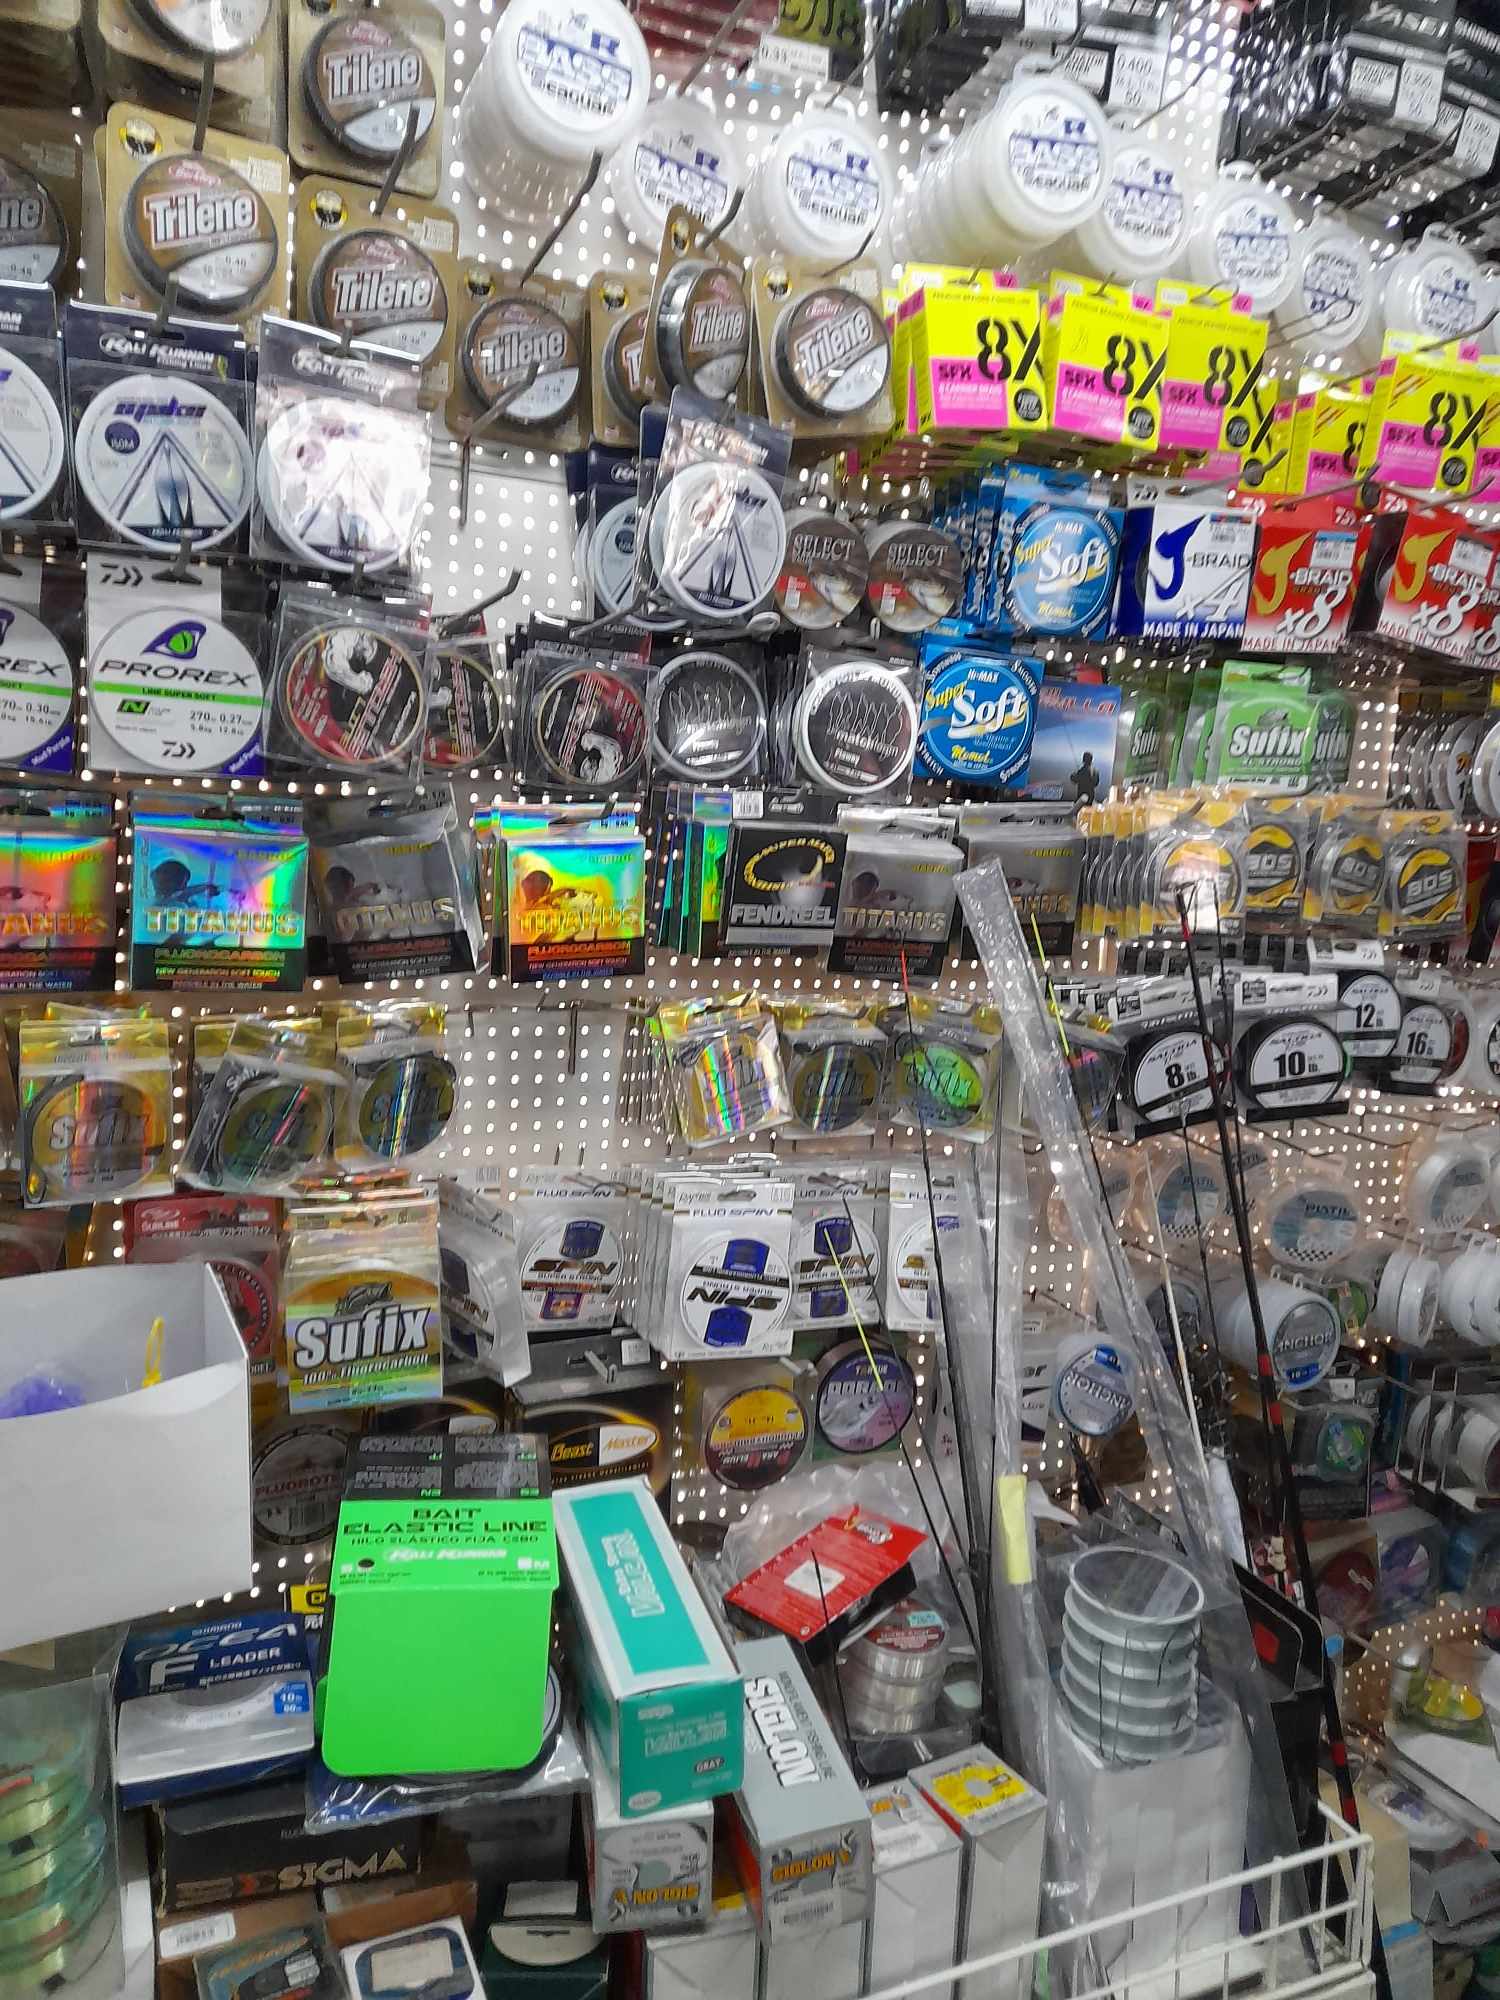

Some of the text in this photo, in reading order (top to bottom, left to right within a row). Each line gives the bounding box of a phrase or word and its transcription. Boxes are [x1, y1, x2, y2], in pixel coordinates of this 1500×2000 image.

[326, 49, 421, 99] Trilene
[147, 194, 259, 249] Trilene
[335, 266, 437, 319] Trilene
[692, 301, 744, 348] Trilene
[150, 344, 214, 362] KUNNAN
[480, 331, 566, 376] Trilene
[796, 308, 873, 375] Trilene
[977, 319, 1043, 381] 8X
[1103, 334, 1168, 400] 8X
[1204, 346, 1264, 408] 8X
[1424, 392, 1486, 449] 8X
[1015, 532, 1057, 565] Super
[1039, 537, 1109, 582] Soft
[1276, 586, 1349, 639] x8
[1410, 588, 1482, 638] x8
[1143, 621, 1244, 639] MADE IN JAPAN
[1378, 619, 1408, 640] MADE
[1243, 636, 1342, 651] MADE IN JAPAN
[99, 659, 255, 688] PROREX
[164, 687, 192, 698] SUPER
[194, 690, 216, 701] SOFT
[925, 680, 969, 712] Super
[951, 687, 1030, 733] Soft
[1230, 722, 1306, 758] Sufix
[0, 911, 108, 937] ANUS
[144, 907, 300, 936] TITANUS
[519, 907, 640, 933] TITANUS
[730, 903, 836, 927] FENDREEL
[842, 907, 948, 931] TITANUS
[154, 948, 286, 962] FLUOROCARBON
[528, 941, 630, 957] FLUOROCARBON
[155, 967, 175, 976] NEW
[176, 967, 229, 977] GENERATION
[230, 968, 251, 977] SOFT
[45, 981, 73, 990] WATER
[1356, 1003, 1376, 1029] 12
[1407, 1032, 1429, 1056] 16
[1164, 1062, 1185, 1089] 8
[1273, 1051, 1306, 1079] 10
[536, 1189, 612, 1198] FLUO SPIN
[692, 1207, 773, 1217] FLUO SPIN
[529, 1258, 618, 1275] SPIN
[687, 1287, 783, 1311] SPIN
[293, 1303, 431, 1371] Sufix
[1275, 1329, 1334, 1354] ANCHOR
[303, 1369, 337, 1386] 100%
[551, 1441, 595, 1462] Beast
[412, 1507, 482, 1520] BAIT
[342, 1520, 548, 1536] ELASTIC LINE
[351, 1536, 386, 1547] HILO
[502, 1535, 539, 1544] CEBO
[150, 1653, 199, 1690] F
[209, 1646, 281, 1670] LEADER
[744, 1676, 821, 1788] SIGLON
[697, 1759, 723, 1773] GRAY
[277, 1845, 408, 1890] SIGMA
